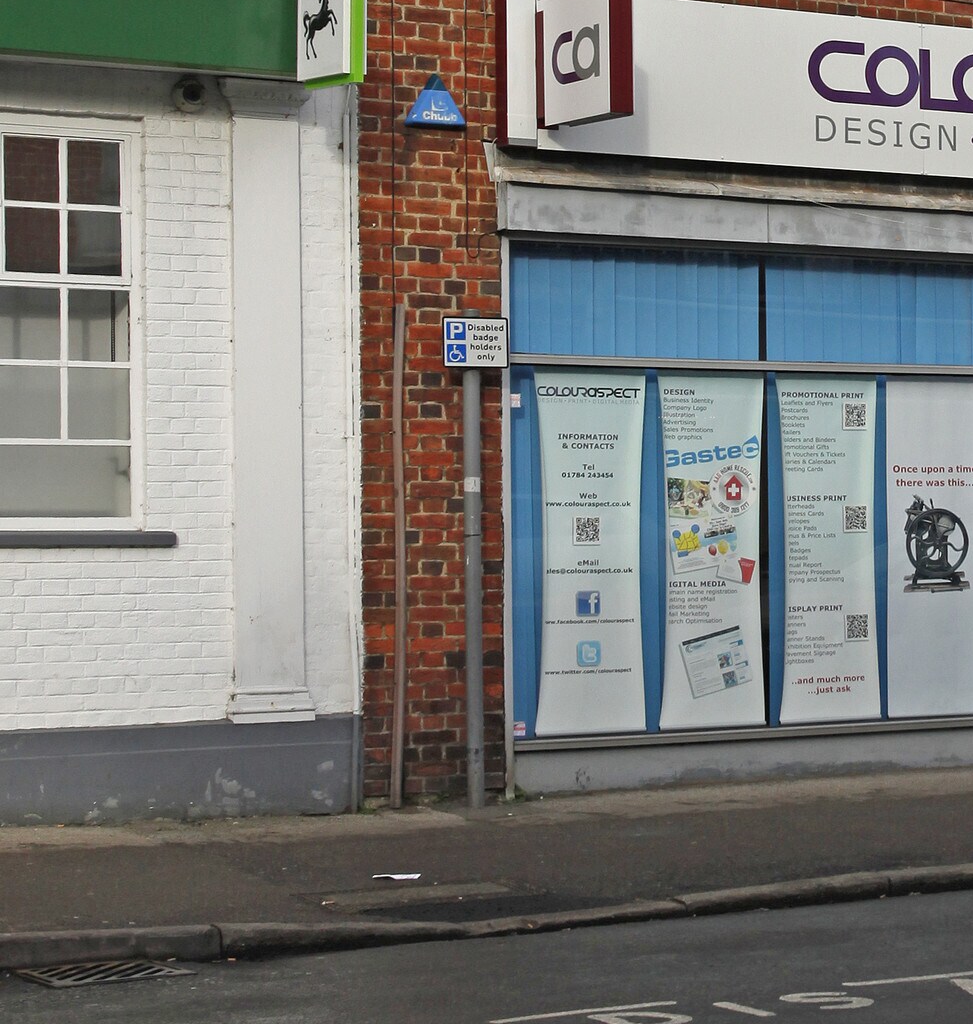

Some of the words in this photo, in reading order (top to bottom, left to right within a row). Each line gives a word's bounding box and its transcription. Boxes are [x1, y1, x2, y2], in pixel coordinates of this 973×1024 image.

[814, 114, 957, 152] DESIGN
[450, 323, 463, 339] P
[473, 334, 498, 342] badge
[477, 353, 495, 361] only
[558, 433, 618, 441] INFORMATION
[893, 465, 918, 473] Once
[921, 466, 944, 475] upon
[896, 479, 923, 487] there
[947, 478, 973, 487] this...
[816, 675, 840, 683] much
